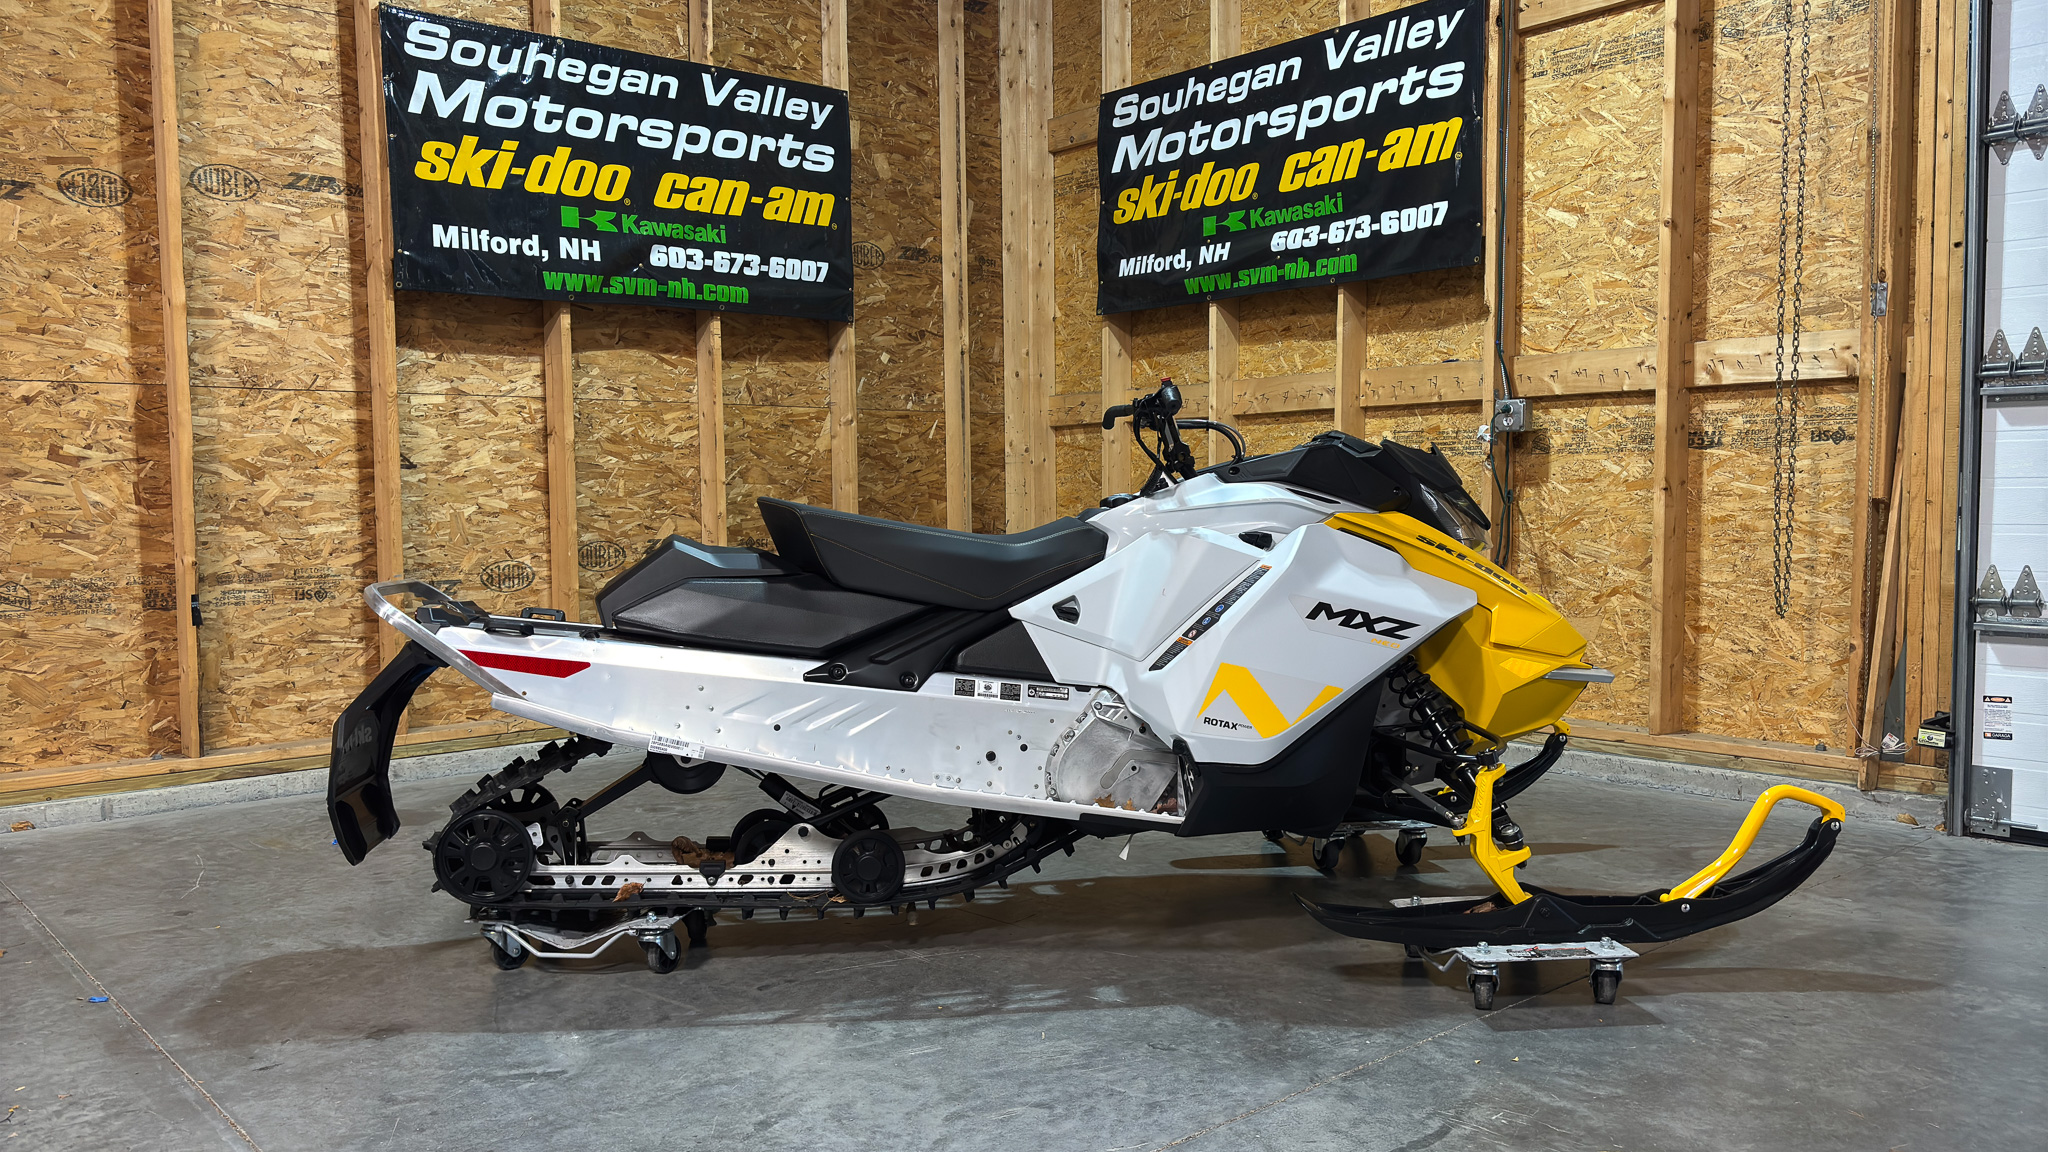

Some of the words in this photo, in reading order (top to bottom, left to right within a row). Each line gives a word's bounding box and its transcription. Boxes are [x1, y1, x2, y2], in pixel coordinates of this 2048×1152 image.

[403, 20, 678, 99] Souhegan
[702, 73, 833, 130] Valley
[1112, 56, 1302, 128] Souhegan
[1324, 9, 1465, 70] Valley
[407, 70, 835, 172] Motorsports
[1111, 61, 1465, 173] Motorsports
[414, 136, 631, 202] ski-doo
[653, 171, 835, 226] can-am
[1114, 161, 1260, 225] ski-doo
[1279, 117, 1463, 192] can-am
[621, 214, 727, 244] Kawasaki
[1250, 192, 1344, 229] Kawasaki
[1270, 201, 1449, 252] 603-673-6007
[432, 223, 550, 261] Milford,
[559, 238, 601, 262] NH
[1118, 248, 1192, 278] Milford,
[1199, 242, 1231, 266] NH
[650, 244, 829, 283] 603-673-6007
[1184, 251, 1358, 295] www.svm-nh.com
[543, 271, 749, 303] www.svm-nh.com
[1305, 601, 1421, 640] MXZ
[1371, 638, 1401, 649] NEO
[1203, 716, 1239, 731] ROTAX
